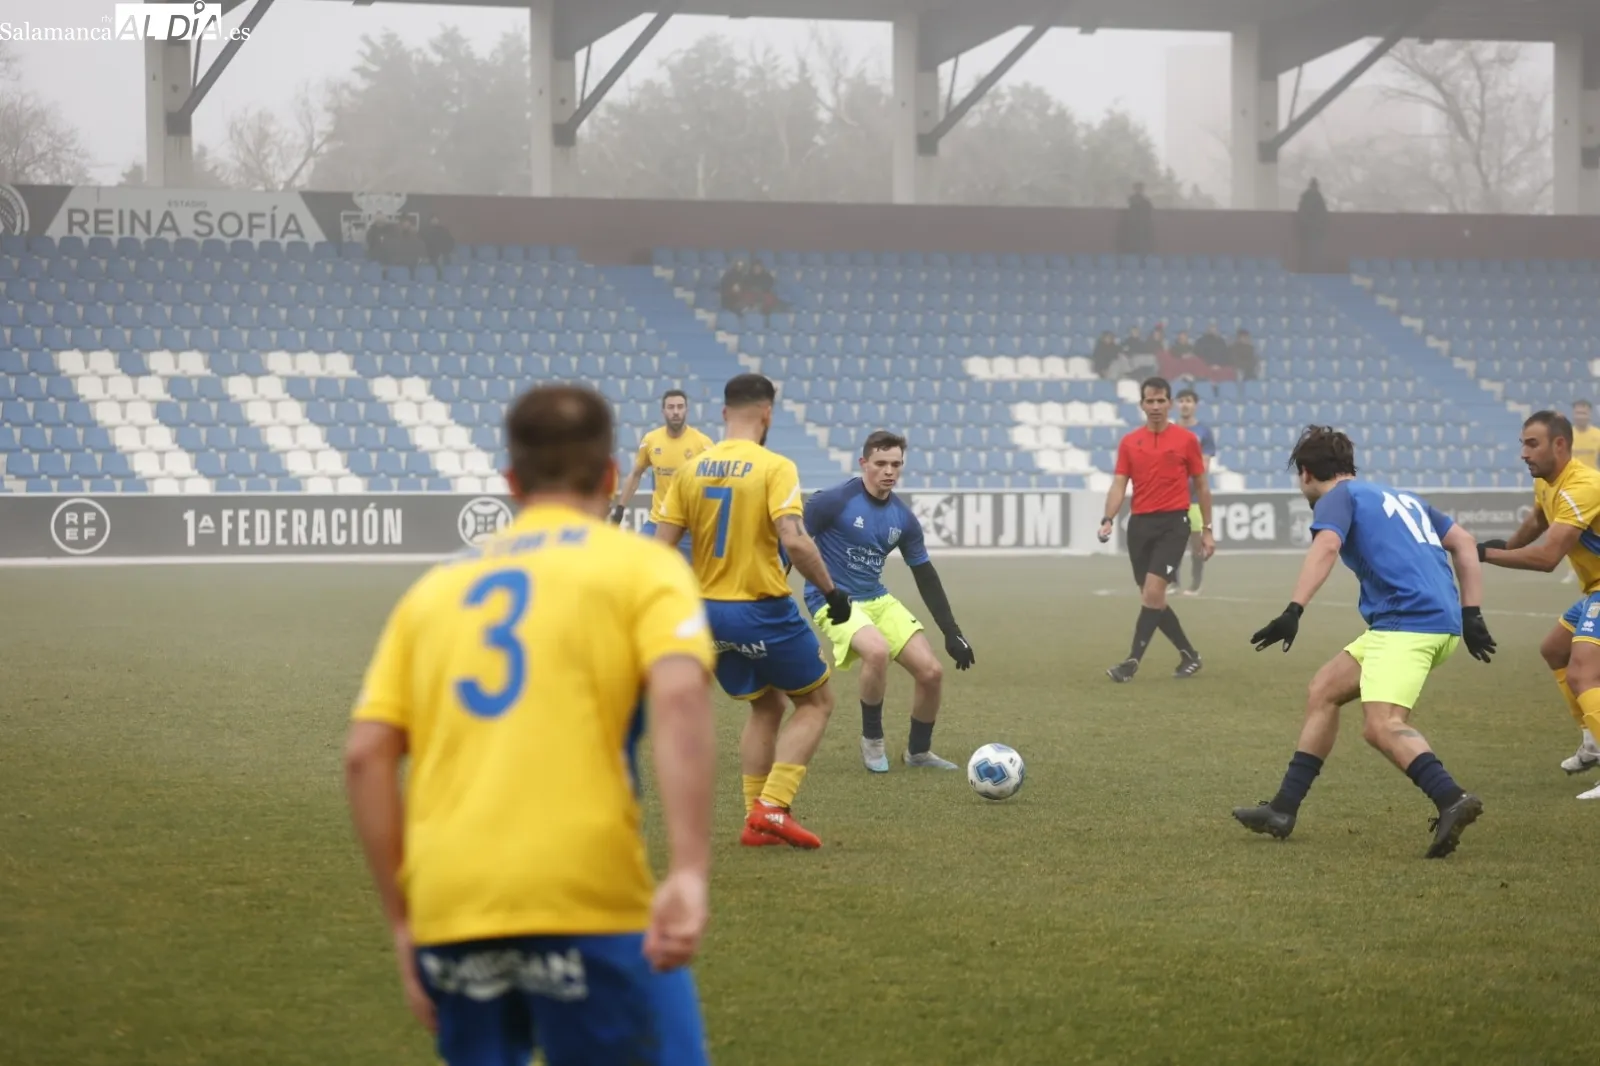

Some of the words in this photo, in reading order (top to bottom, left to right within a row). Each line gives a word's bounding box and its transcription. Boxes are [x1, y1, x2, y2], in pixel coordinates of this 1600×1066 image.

[67, 208, 181, 237] REINA
[193, 205, 305, 239] SOFÍA
[221, 502, 403, 547] FEDERACIÓN
[704, 486, 732, 558] 7
[962, 494, 1062, 546] HJM
[1382, 491, 1443, 548] 12
[455, 568, 532, 718] 3
